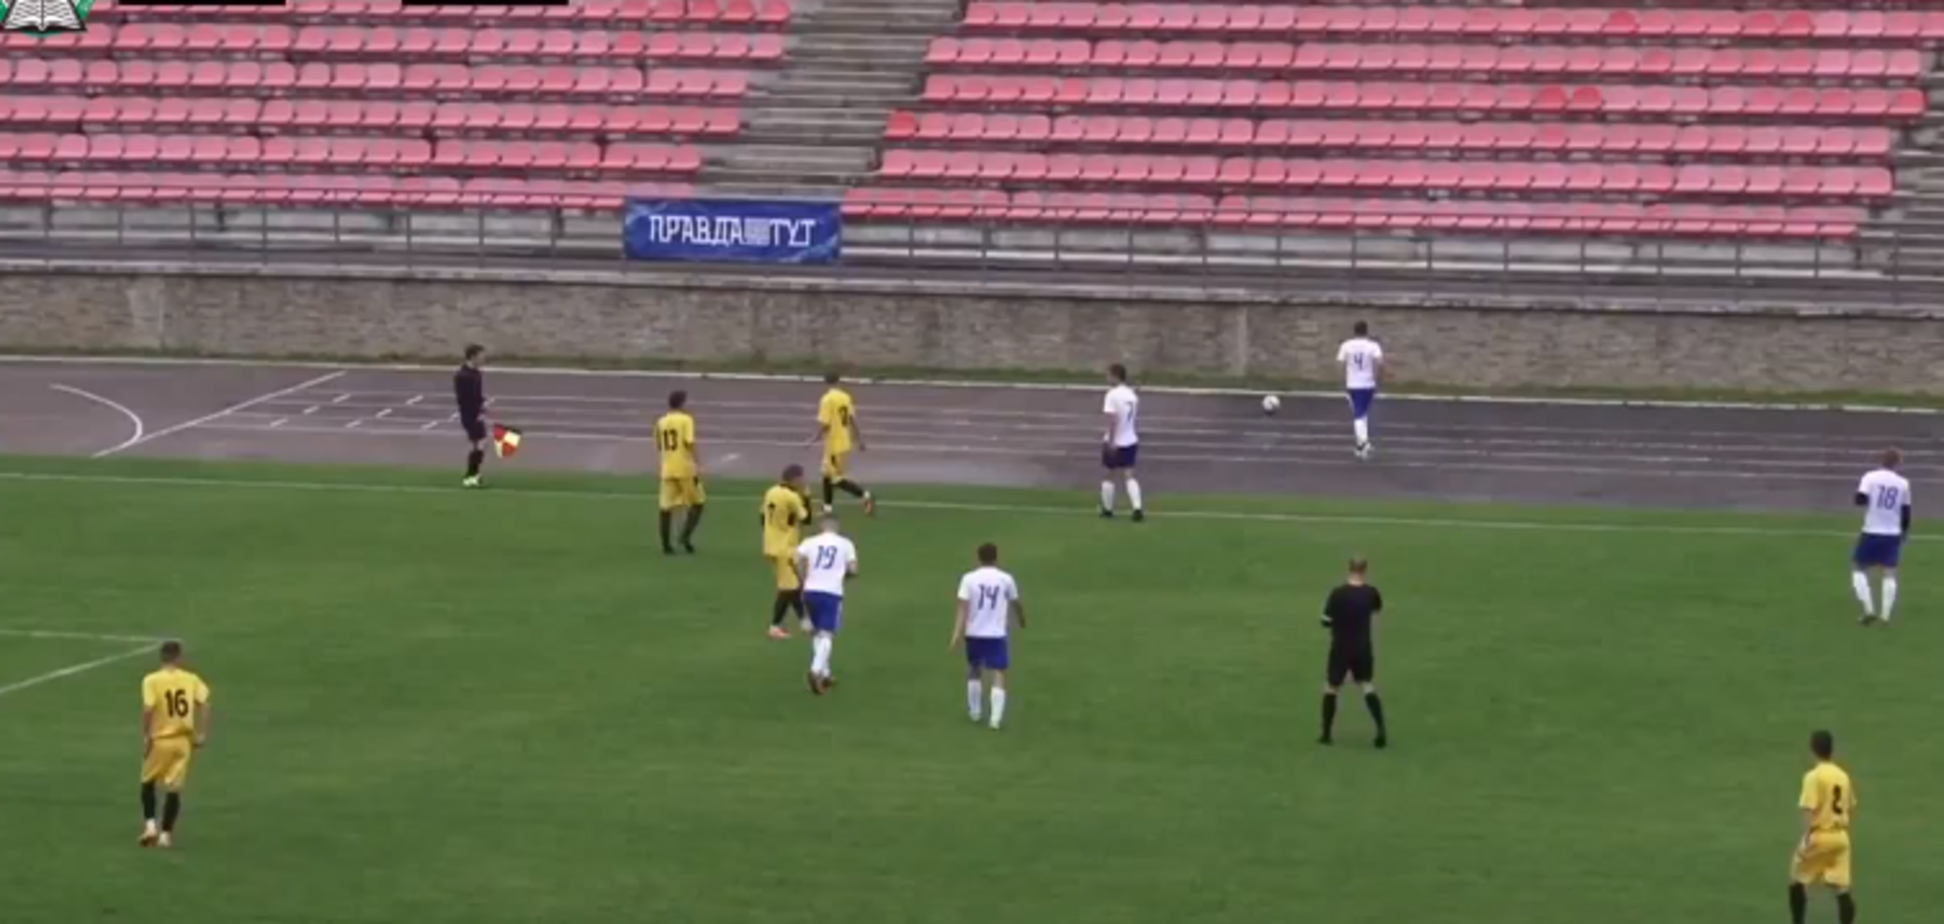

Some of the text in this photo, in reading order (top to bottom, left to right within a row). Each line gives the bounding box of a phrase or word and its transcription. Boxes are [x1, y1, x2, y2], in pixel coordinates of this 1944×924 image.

[649, 215, 816, 247] ПРАВДА ТУТ
[1353, 351, 1364, 371] 4
[663, 428, 678, 452] 13
[1877, 484, 1899, 511] 18
[979, 583, 1000, 611] 14
[165, 688, 189, 718] 16
